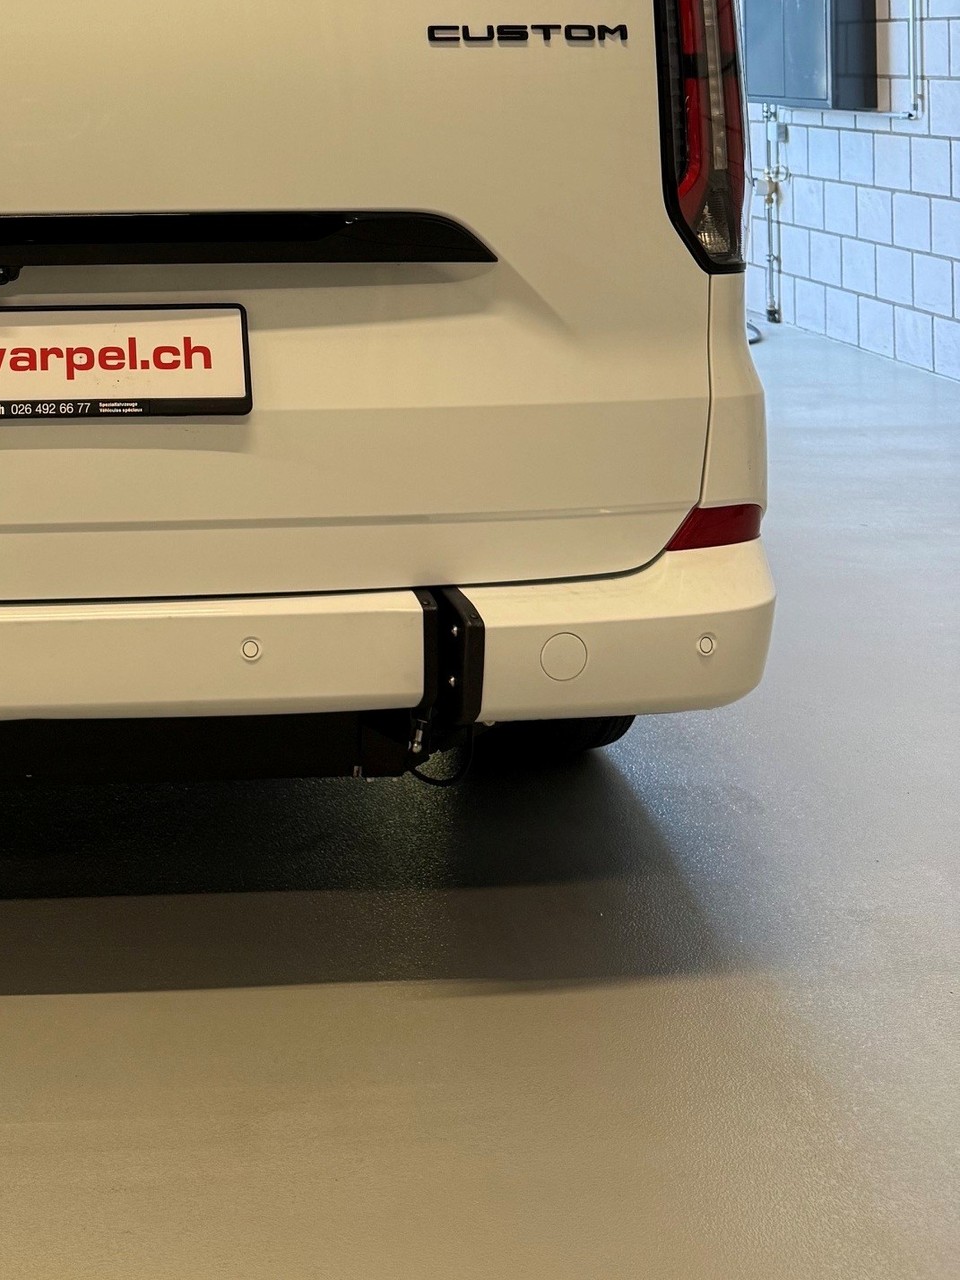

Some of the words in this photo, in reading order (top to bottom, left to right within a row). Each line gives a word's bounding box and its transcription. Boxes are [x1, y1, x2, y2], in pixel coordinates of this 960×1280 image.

[427, 24, 628, 41] CUSTOM
[11, 403, 32, 415] 026
[35, 403, 56, 414] 492
[59, 402, 74, 414] 66
[77, 402, 91, 413] 77
